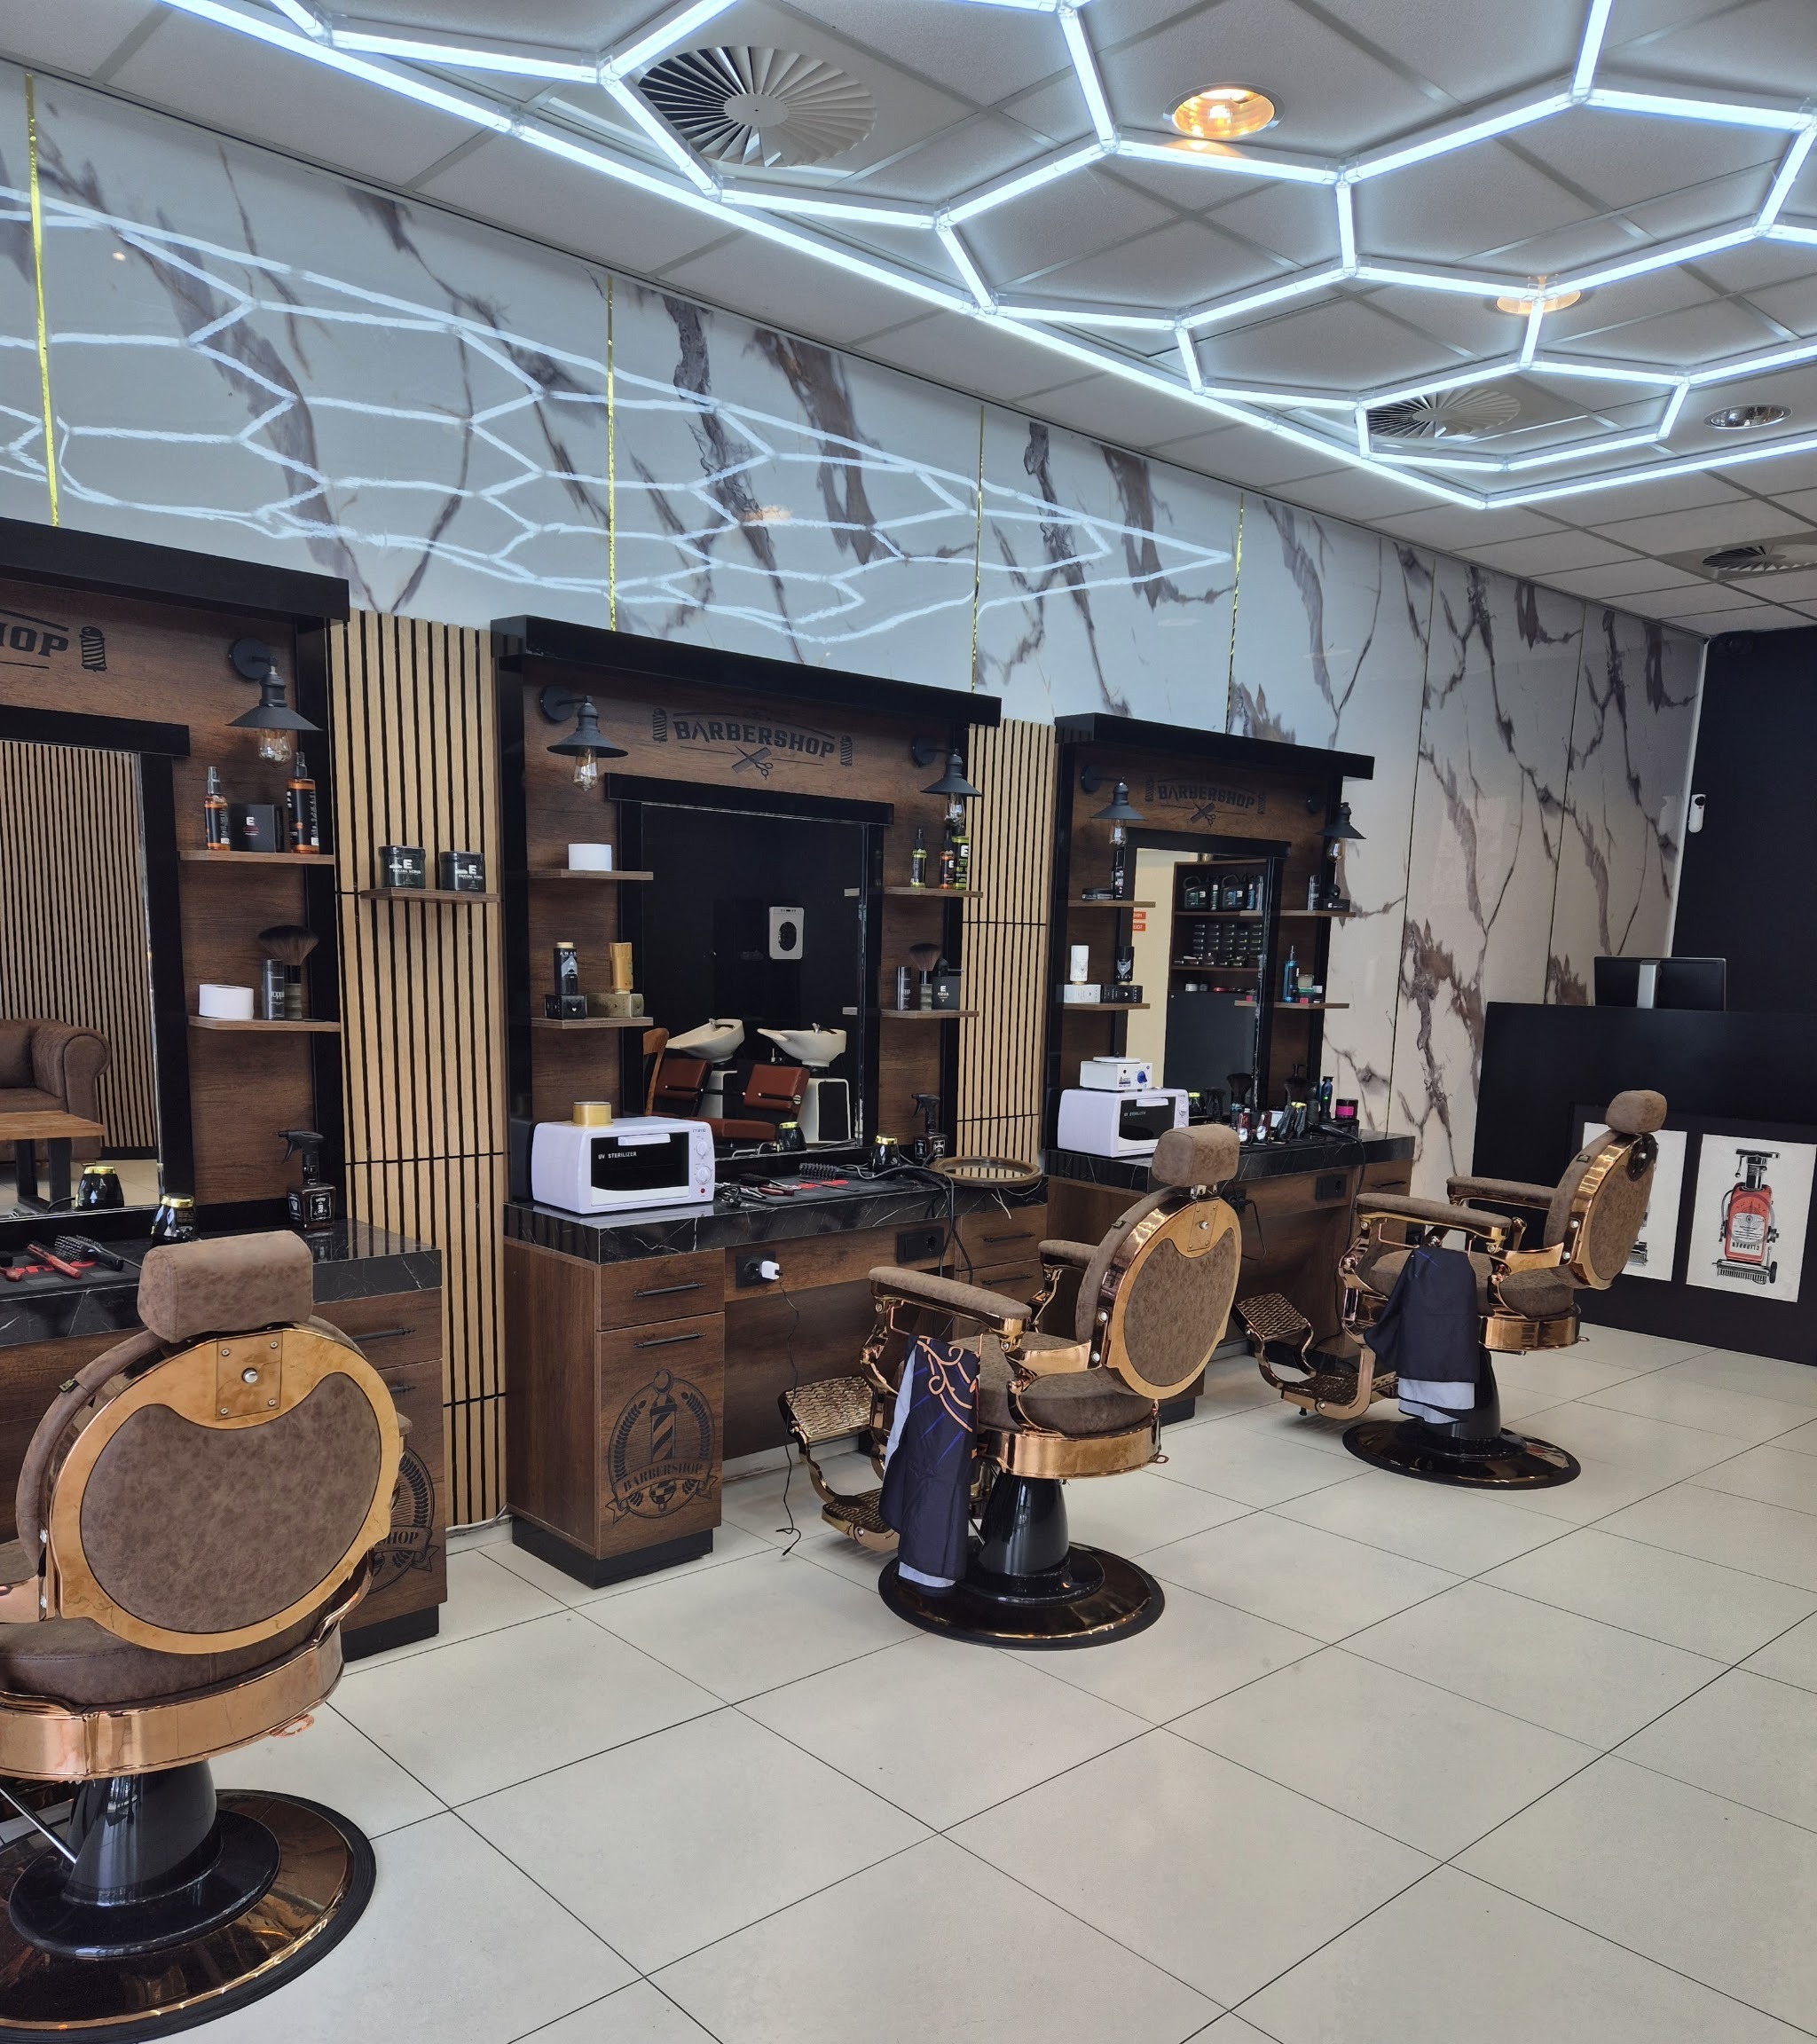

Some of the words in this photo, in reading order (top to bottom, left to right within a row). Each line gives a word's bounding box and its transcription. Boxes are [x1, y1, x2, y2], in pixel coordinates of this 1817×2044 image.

[0, 623, 69, 657] OP
[673, 720, 835, 758] BARBERSHOP
[1157, 785, 1255, 809] BARBERSHOP
[623, 1463, 703, 1492] BARBERSHOP
